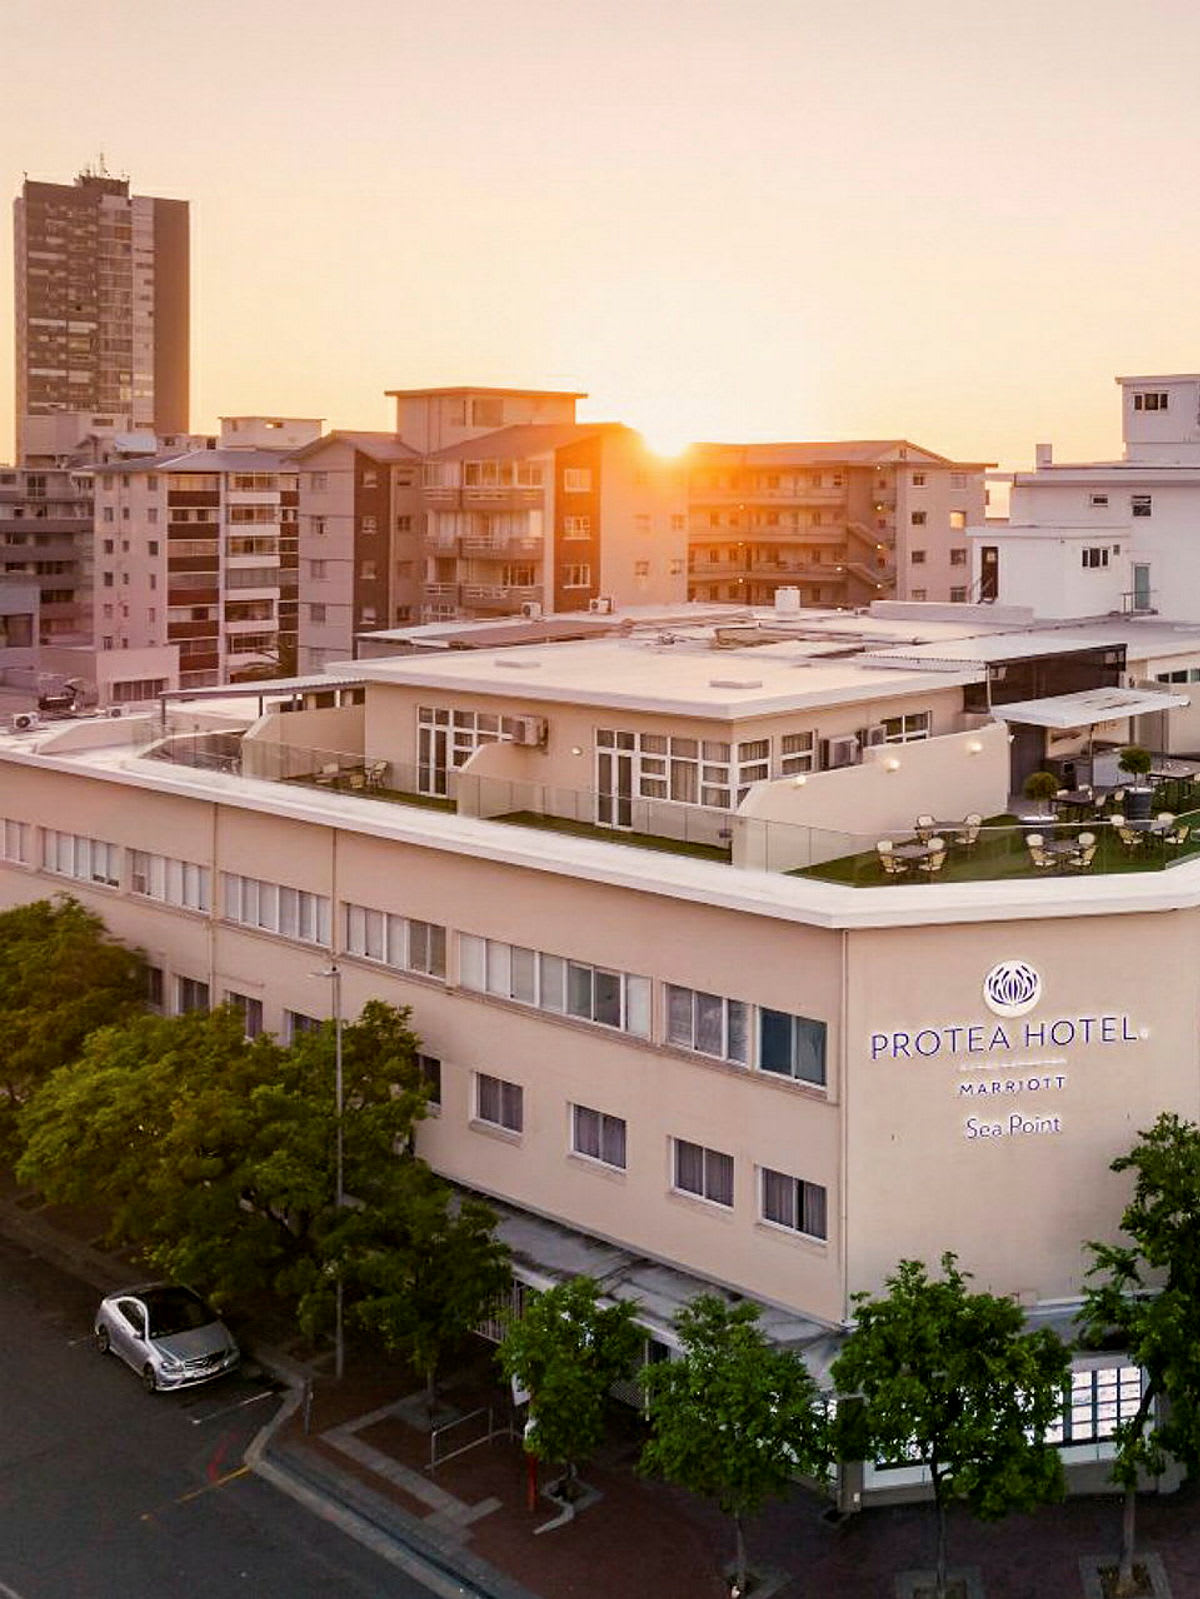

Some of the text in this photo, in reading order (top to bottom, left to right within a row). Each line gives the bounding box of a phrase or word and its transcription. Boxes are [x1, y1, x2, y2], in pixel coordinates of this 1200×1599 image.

[871, 1015, 1138, 1060] PROTEA HOTEL
[959, 1076, 1066, 1096] MARRIOTT
[966, 1114, 1061, 1139] Sea Point
